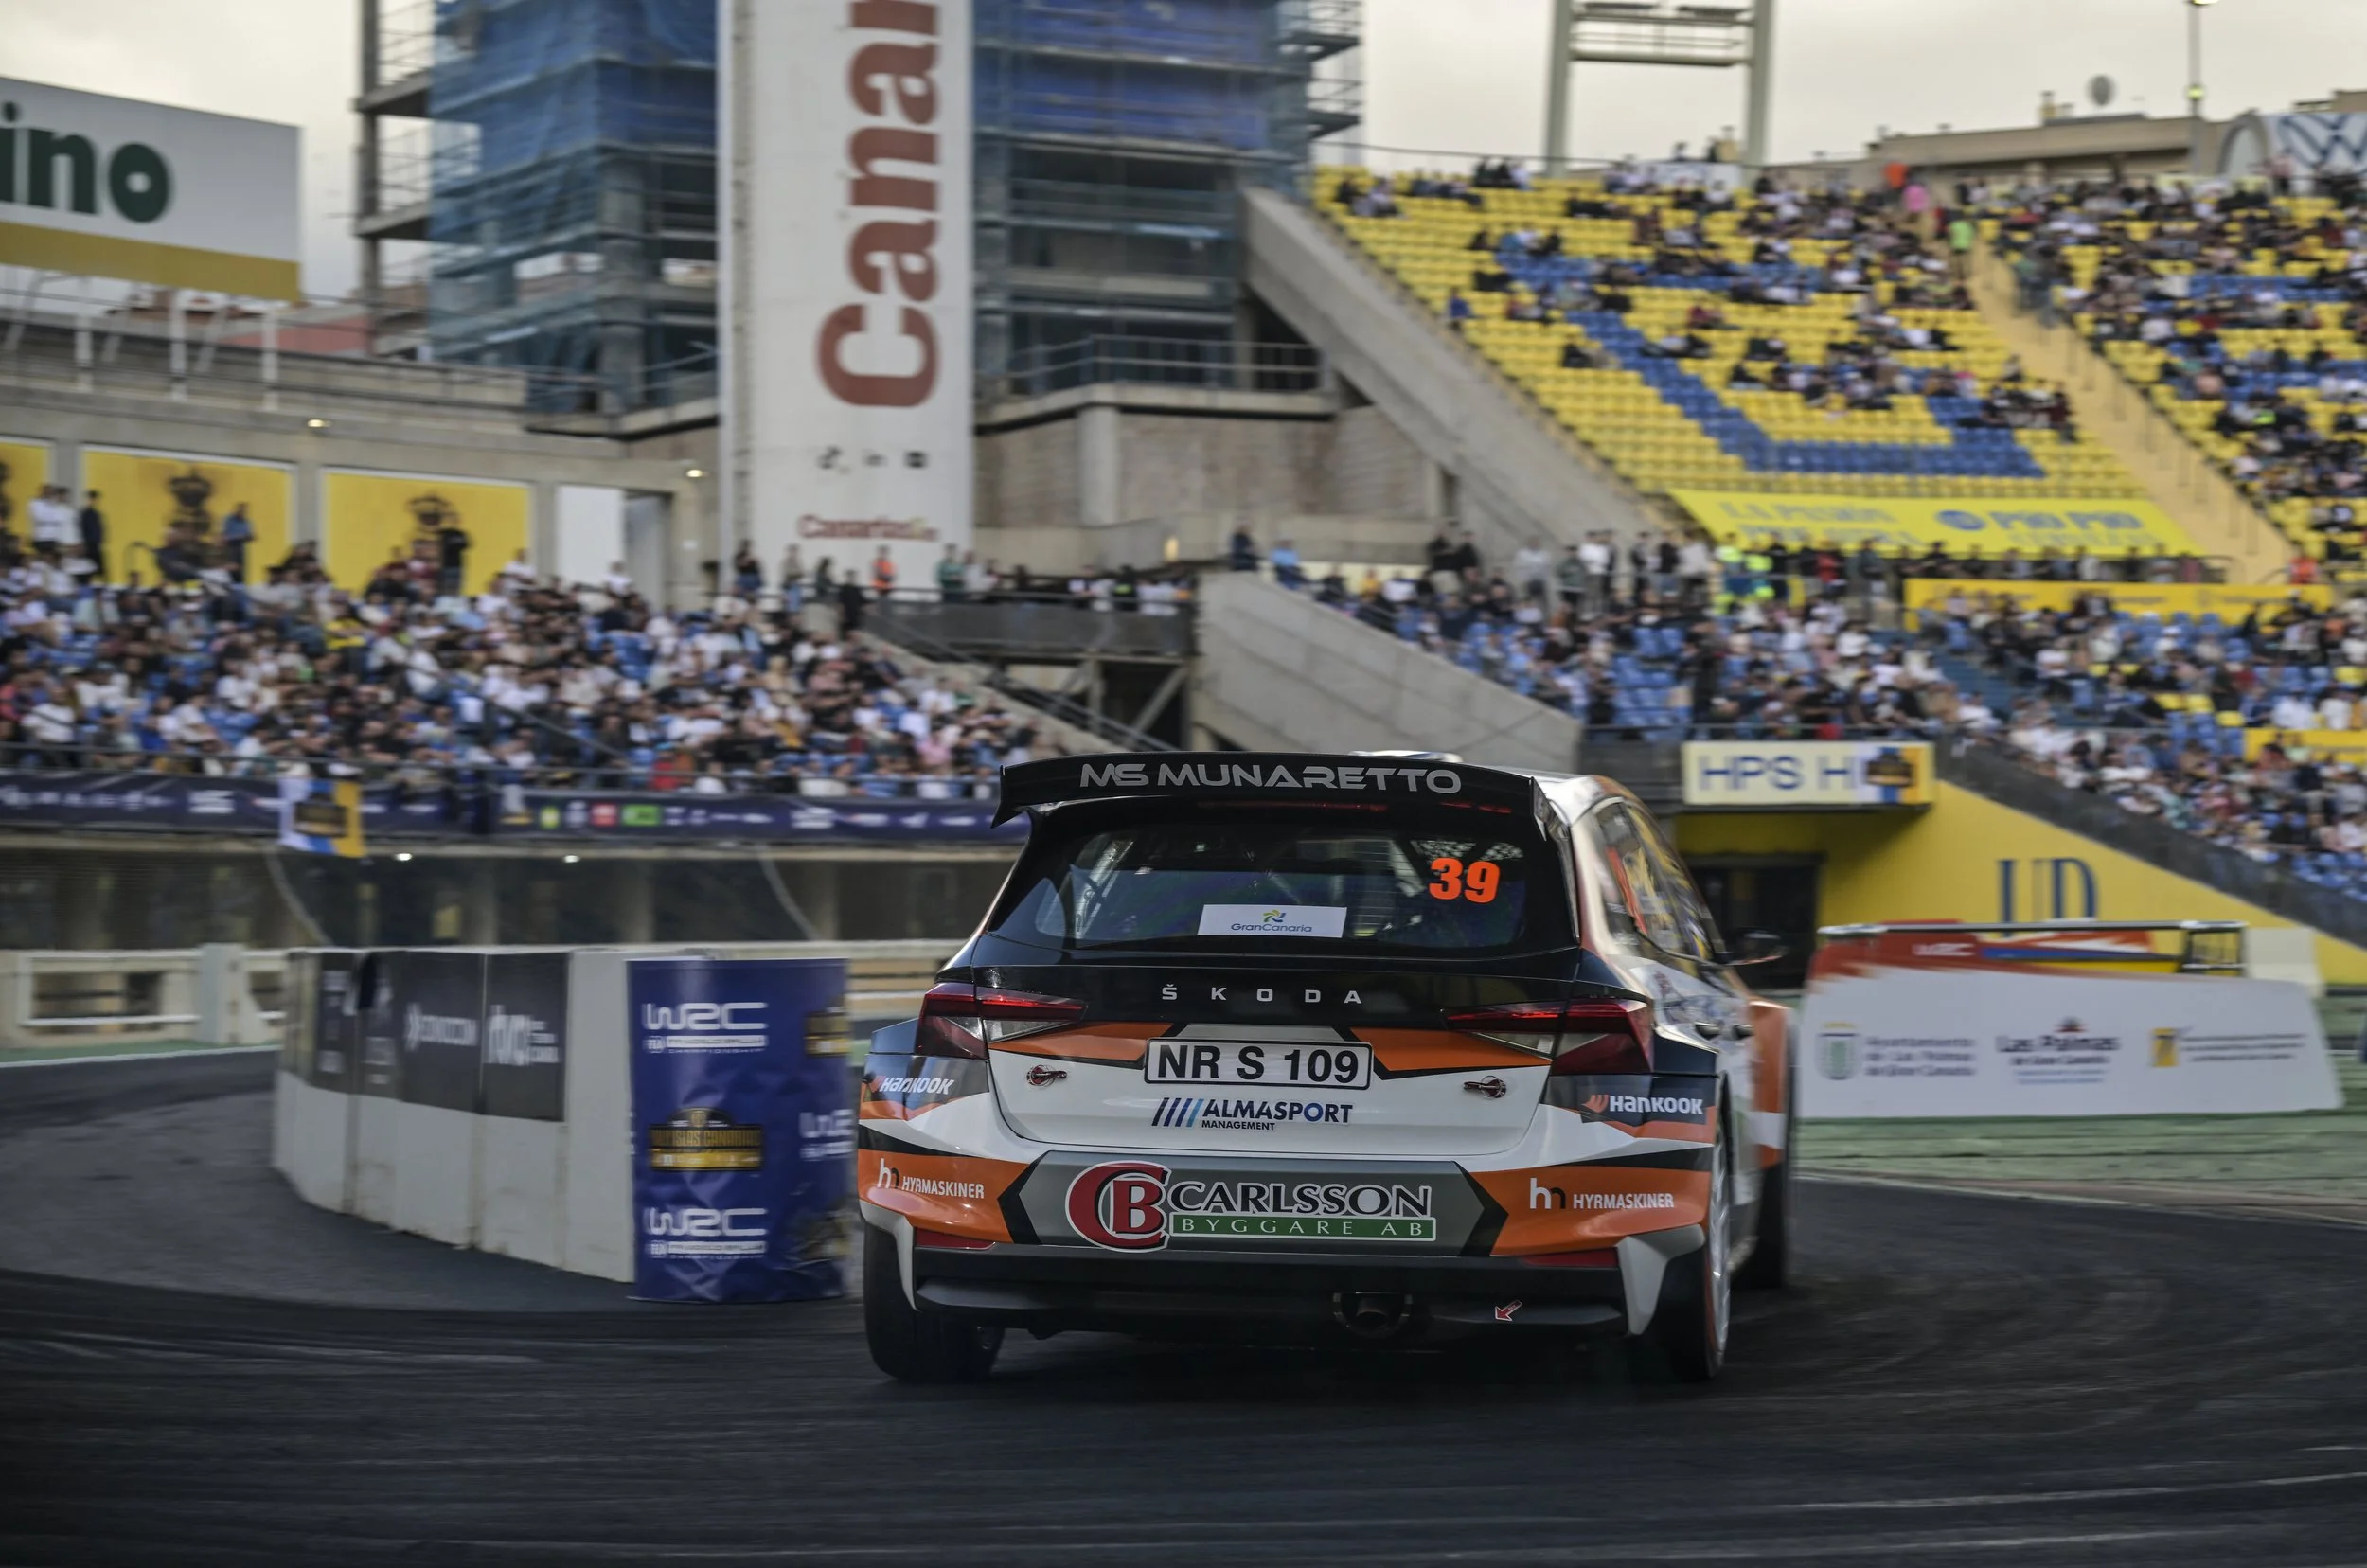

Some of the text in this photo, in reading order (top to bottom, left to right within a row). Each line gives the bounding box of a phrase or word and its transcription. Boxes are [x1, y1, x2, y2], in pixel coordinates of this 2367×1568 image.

[1080, 763, 1462, 793] MS MUNARETTO
[1699, 755, 1803, 791] HPS
[1429, 857, 1501, 903] 39
[1231, 922, 1312, 934] GranCanaria
[1162, 983, 1362, 1005] ŠKODA
[643, 1002, 768, 1031] WRC
[1157, 1044, 1359, 1084] NR S 109
[1201, 1098, 1354, 1124] ALMASPORT
[1201, 1119, 1276, 1131] MANAGEMENT
[901, 1175, 985, 1200] HYRMASKINER
[1168, 1181, 1432, 1217] CARLSSON
[1573, 1193, 1675, 1210] HYRMASKINER
[644, 1206, 768, 1237] WRC
[1182, 1217, 1423, 1237] BYGGARE AB
